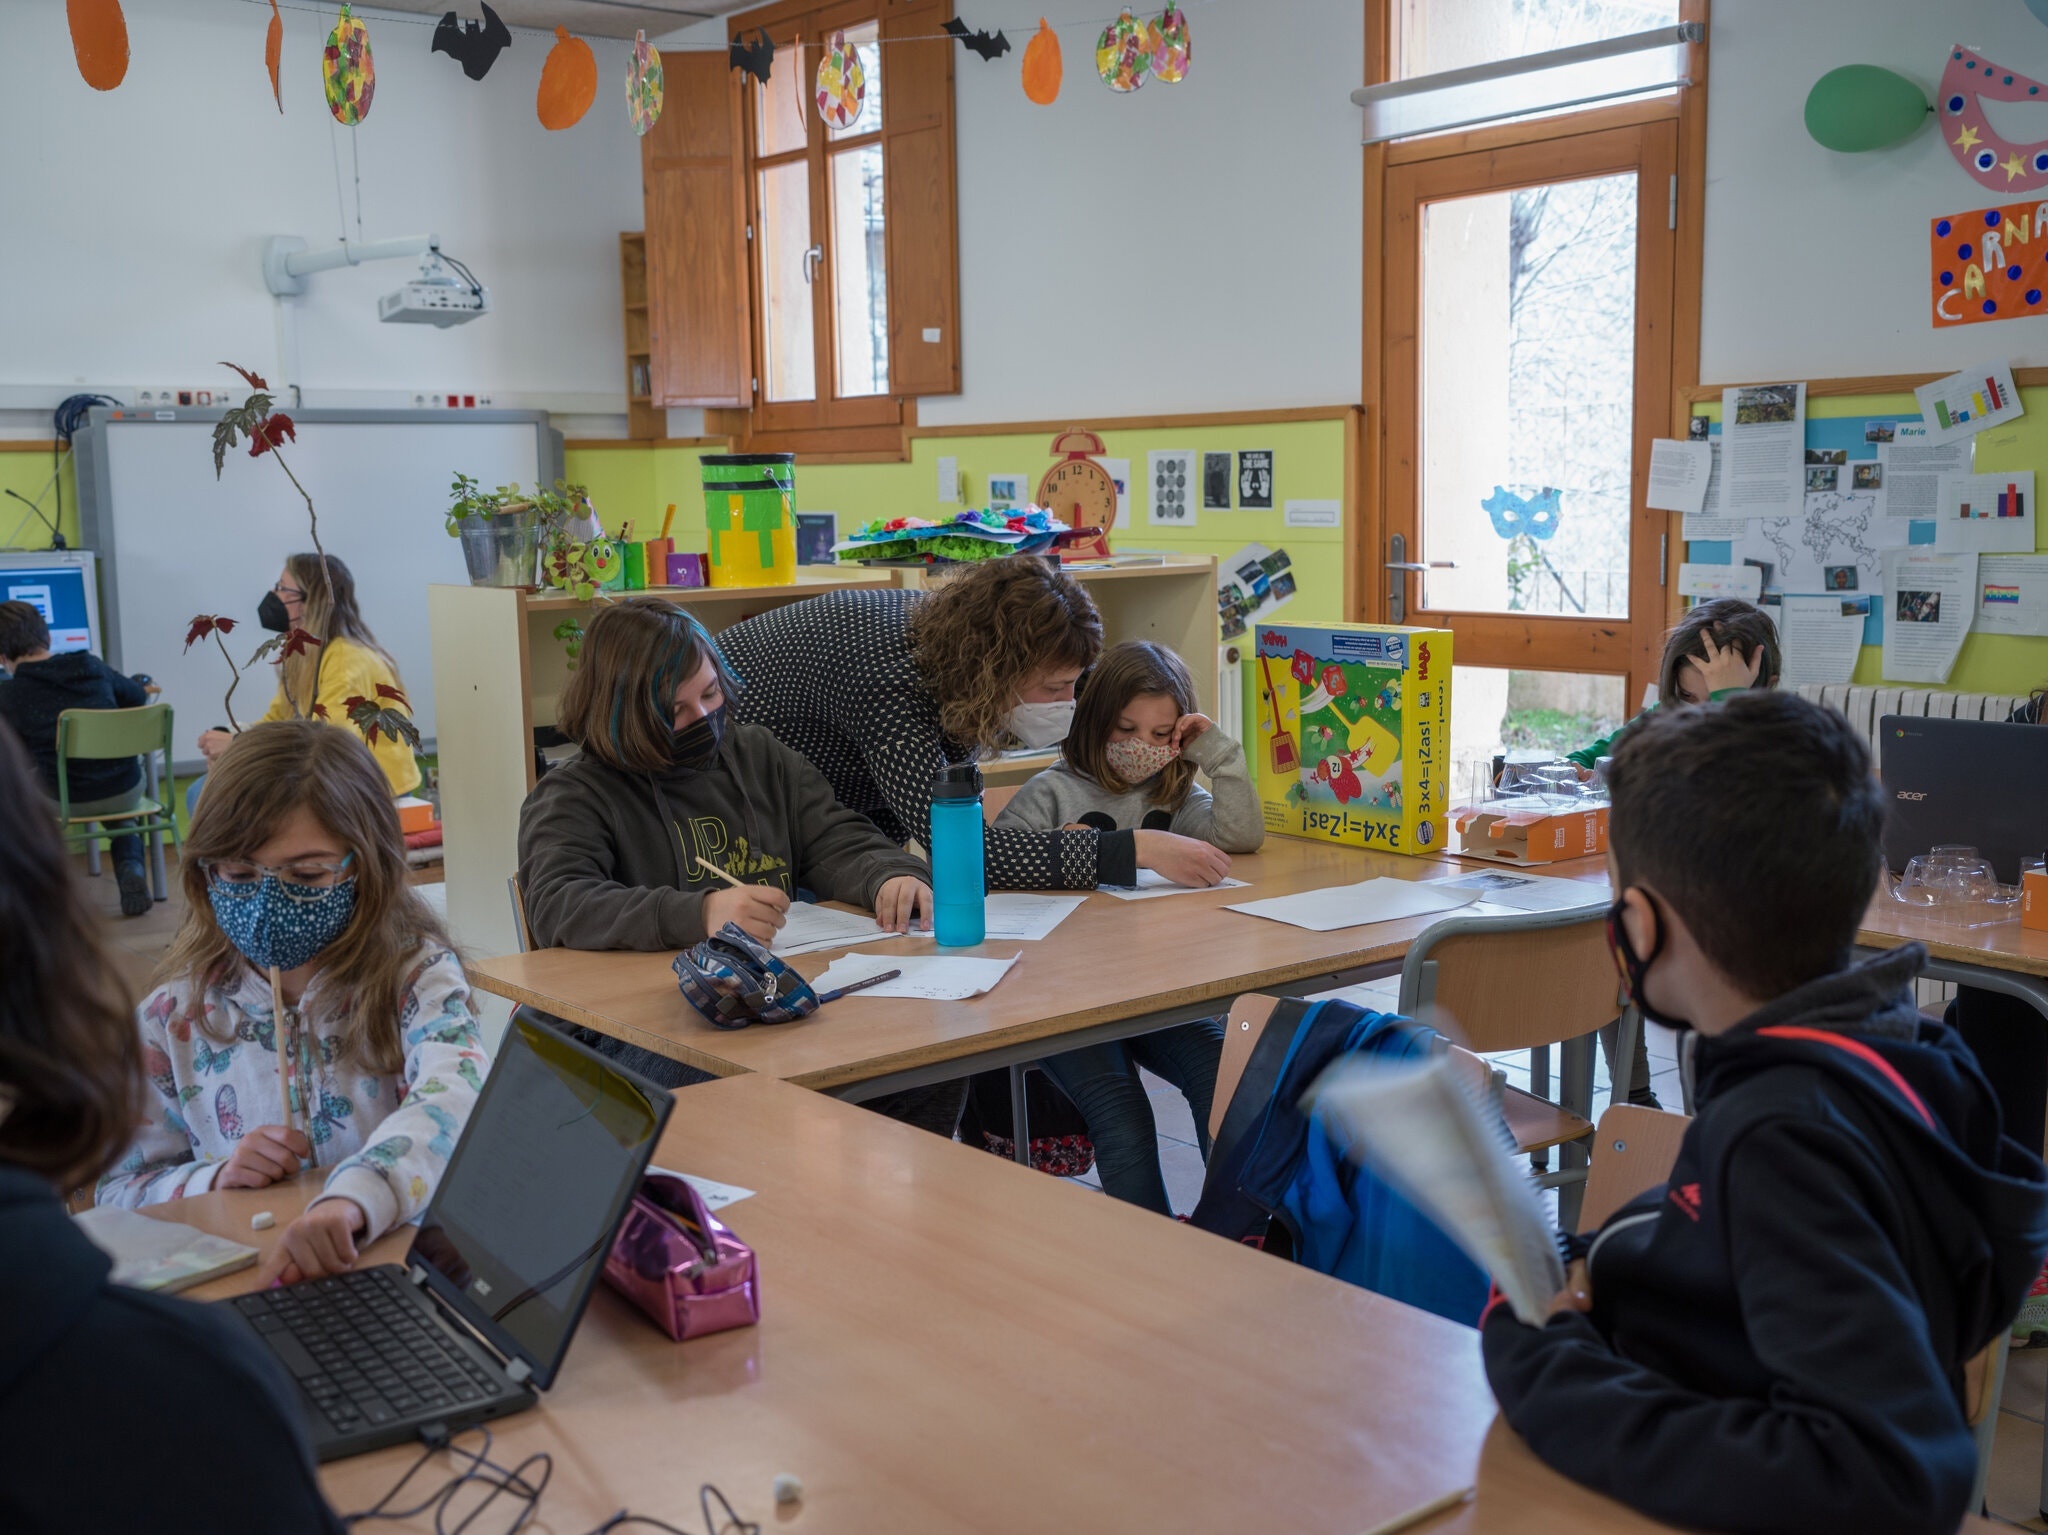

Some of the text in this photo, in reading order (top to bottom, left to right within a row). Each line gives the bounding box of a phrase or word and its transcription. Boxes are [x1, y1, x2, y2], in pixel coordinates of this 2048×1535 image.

[1900, 427, 1926, 436] Marie
[1242, 459, 1270, 469] THE SAME
[1072, 465, 1082, 475] 12
[1089, 470, 1094, 479] 1
[1058, 471, 1066, 480] 11
[1048, 484, 1057, 493] 10
[1100, 481, 1105, 491] 2
[1105, 498, 1110, 508] 3
[1101, 515, 1105, 524] 4
[1262, 630, 1287, 647] HABA
[1418, 641, 1431, 680] HABA
[1332, 762, 1341, 773] 12
[1418, 720, 1433, 813] 3x4=¡Zas!
[1897, 791, 1928, 801] acer
[1302, 810, 1401, 847] 3x4=¡Zas!
[673, 816, 728, 882] UP
